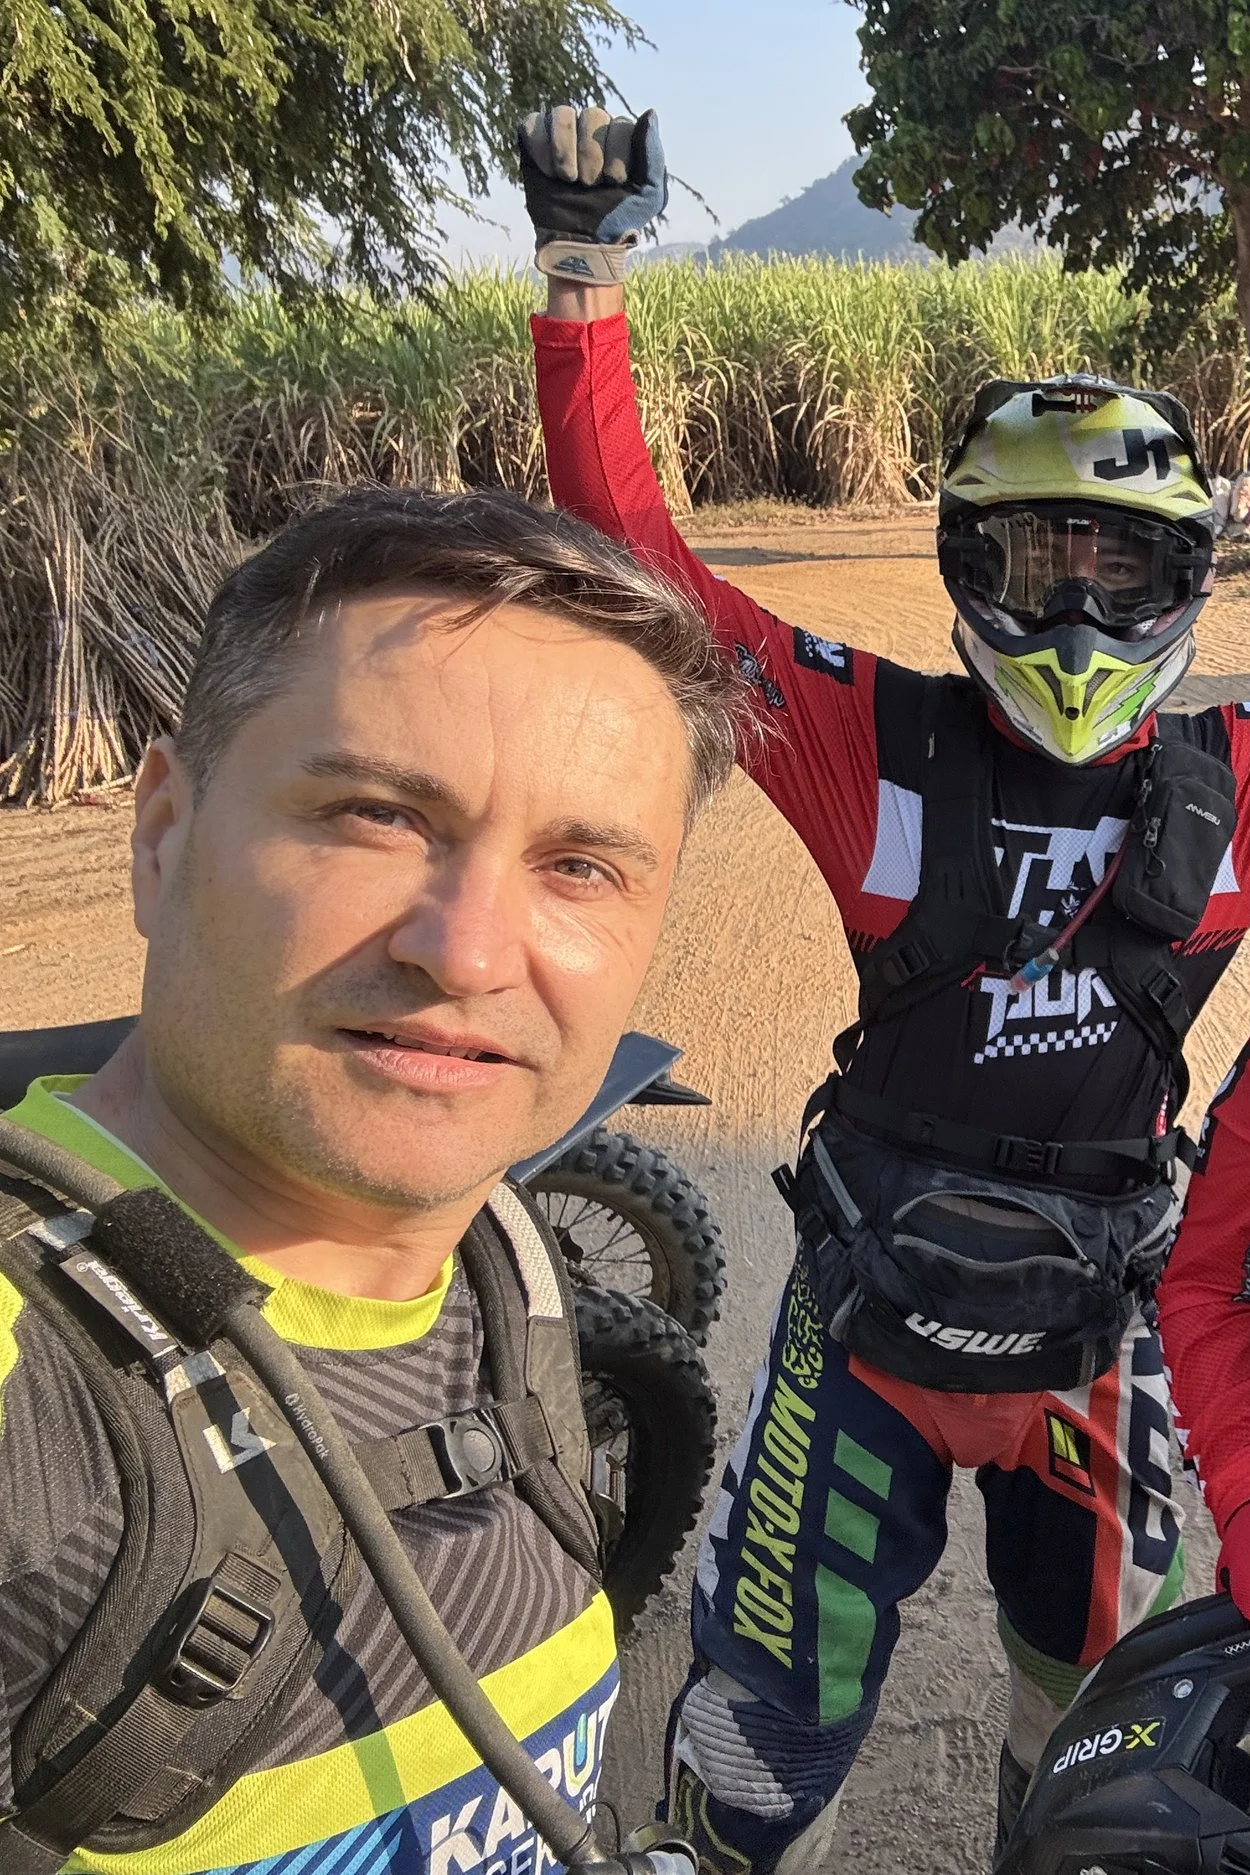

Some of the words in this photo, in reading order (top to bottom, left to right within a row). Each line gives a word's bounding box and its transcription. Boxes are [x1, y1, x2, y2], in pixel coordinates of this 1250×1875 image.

[86, 1260, 169, 1342] Kriega
[292, 1404, 330, 1460] HydroPak
[733, 1546, 795, 1670] FOX
[1053, 1720, 1161, 1775] X-GRIP
